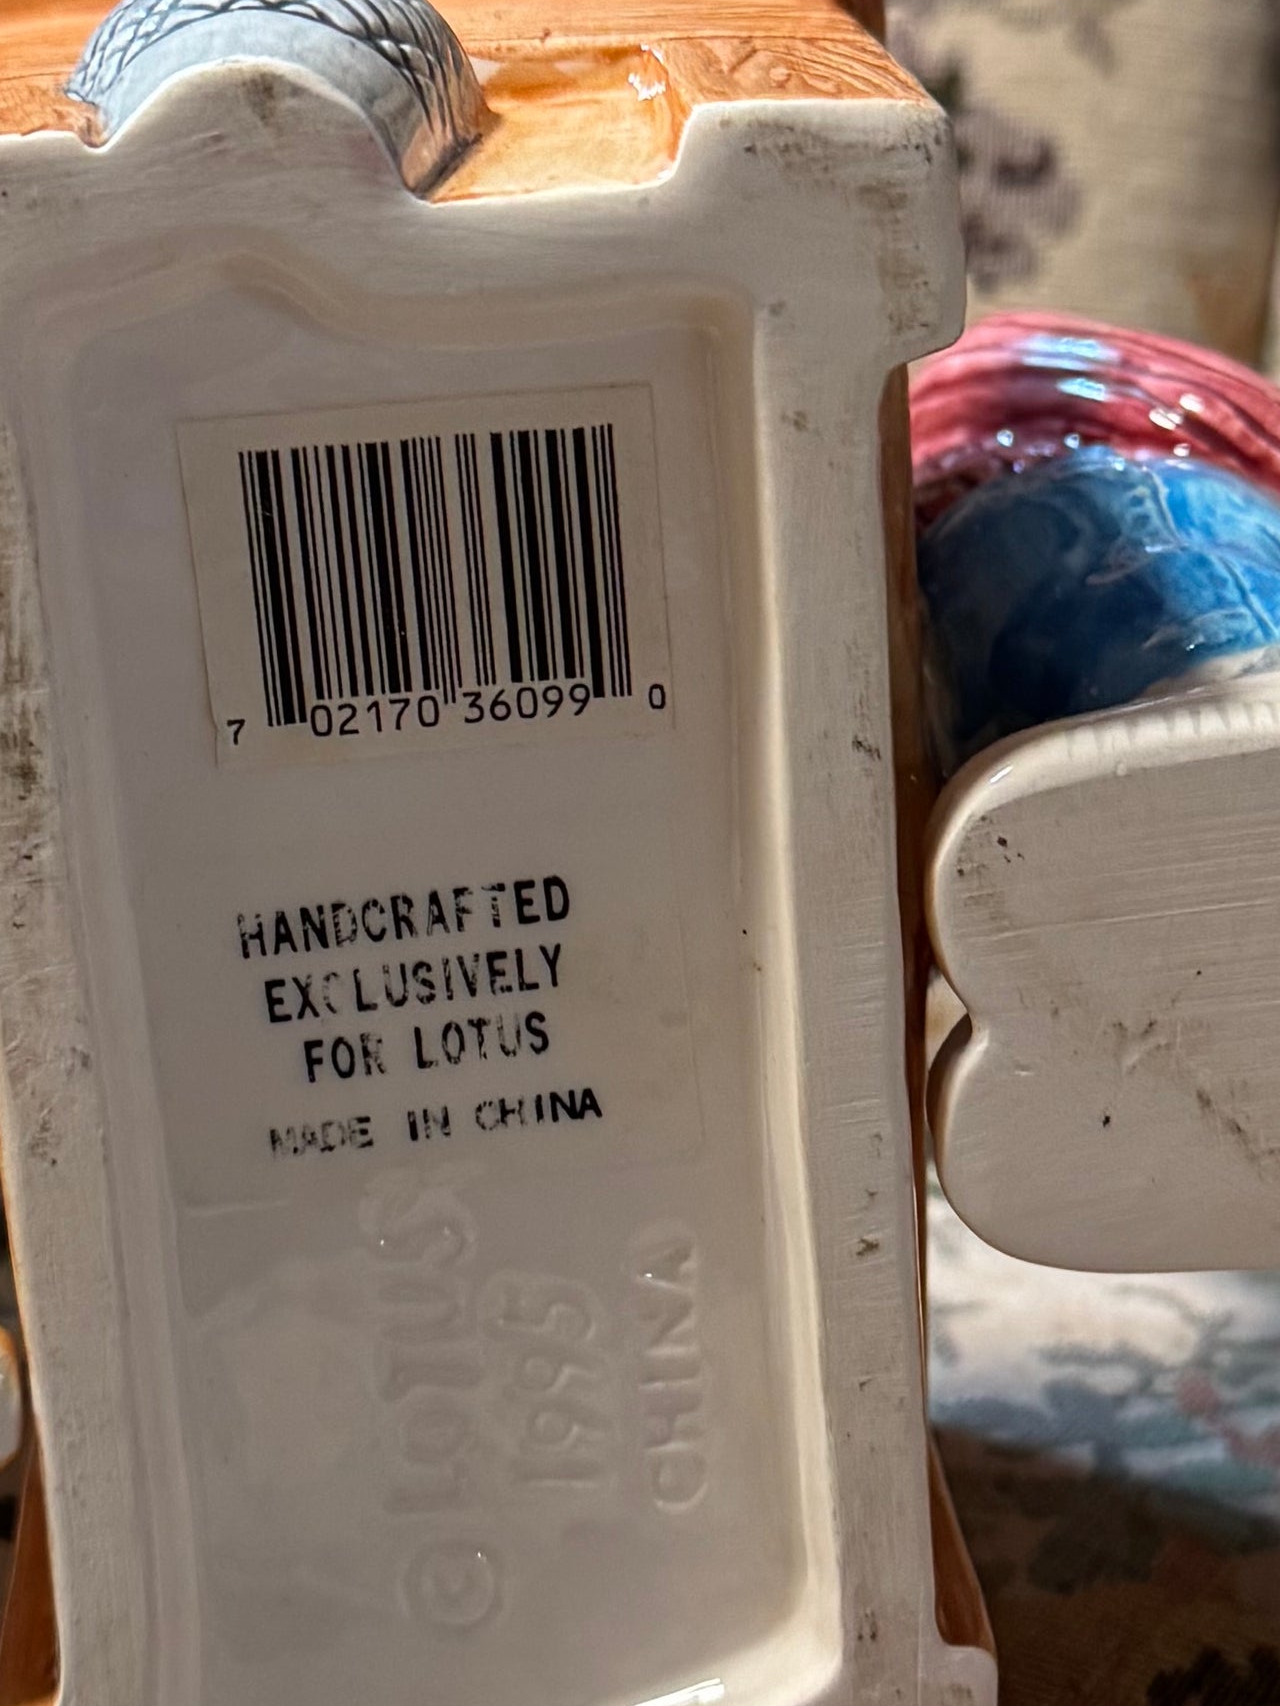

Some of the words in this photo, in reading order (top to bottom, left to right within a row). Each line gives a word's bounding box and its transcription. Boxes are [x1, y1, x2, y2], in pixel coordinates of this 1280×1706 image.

[227, 720, 245, 744] 7
[311, 697, 440, 737] 02170
[463, 684, 591, 724] 36099
[236, 875, 570, 959] HANDCRAFTED
[264, 944, 561, 1023] EXCLUSIVELY
[304, 1033, 387, 1082] FOR
[413, 1012, 550, 1069] LOTUS
[269, 1117, 374, 1159] MADE
[408, 1106, 451, 1142] IN
[475, 1089, 603, 1131] CHINA
[632, 1228, 706, 1515] CHINA
